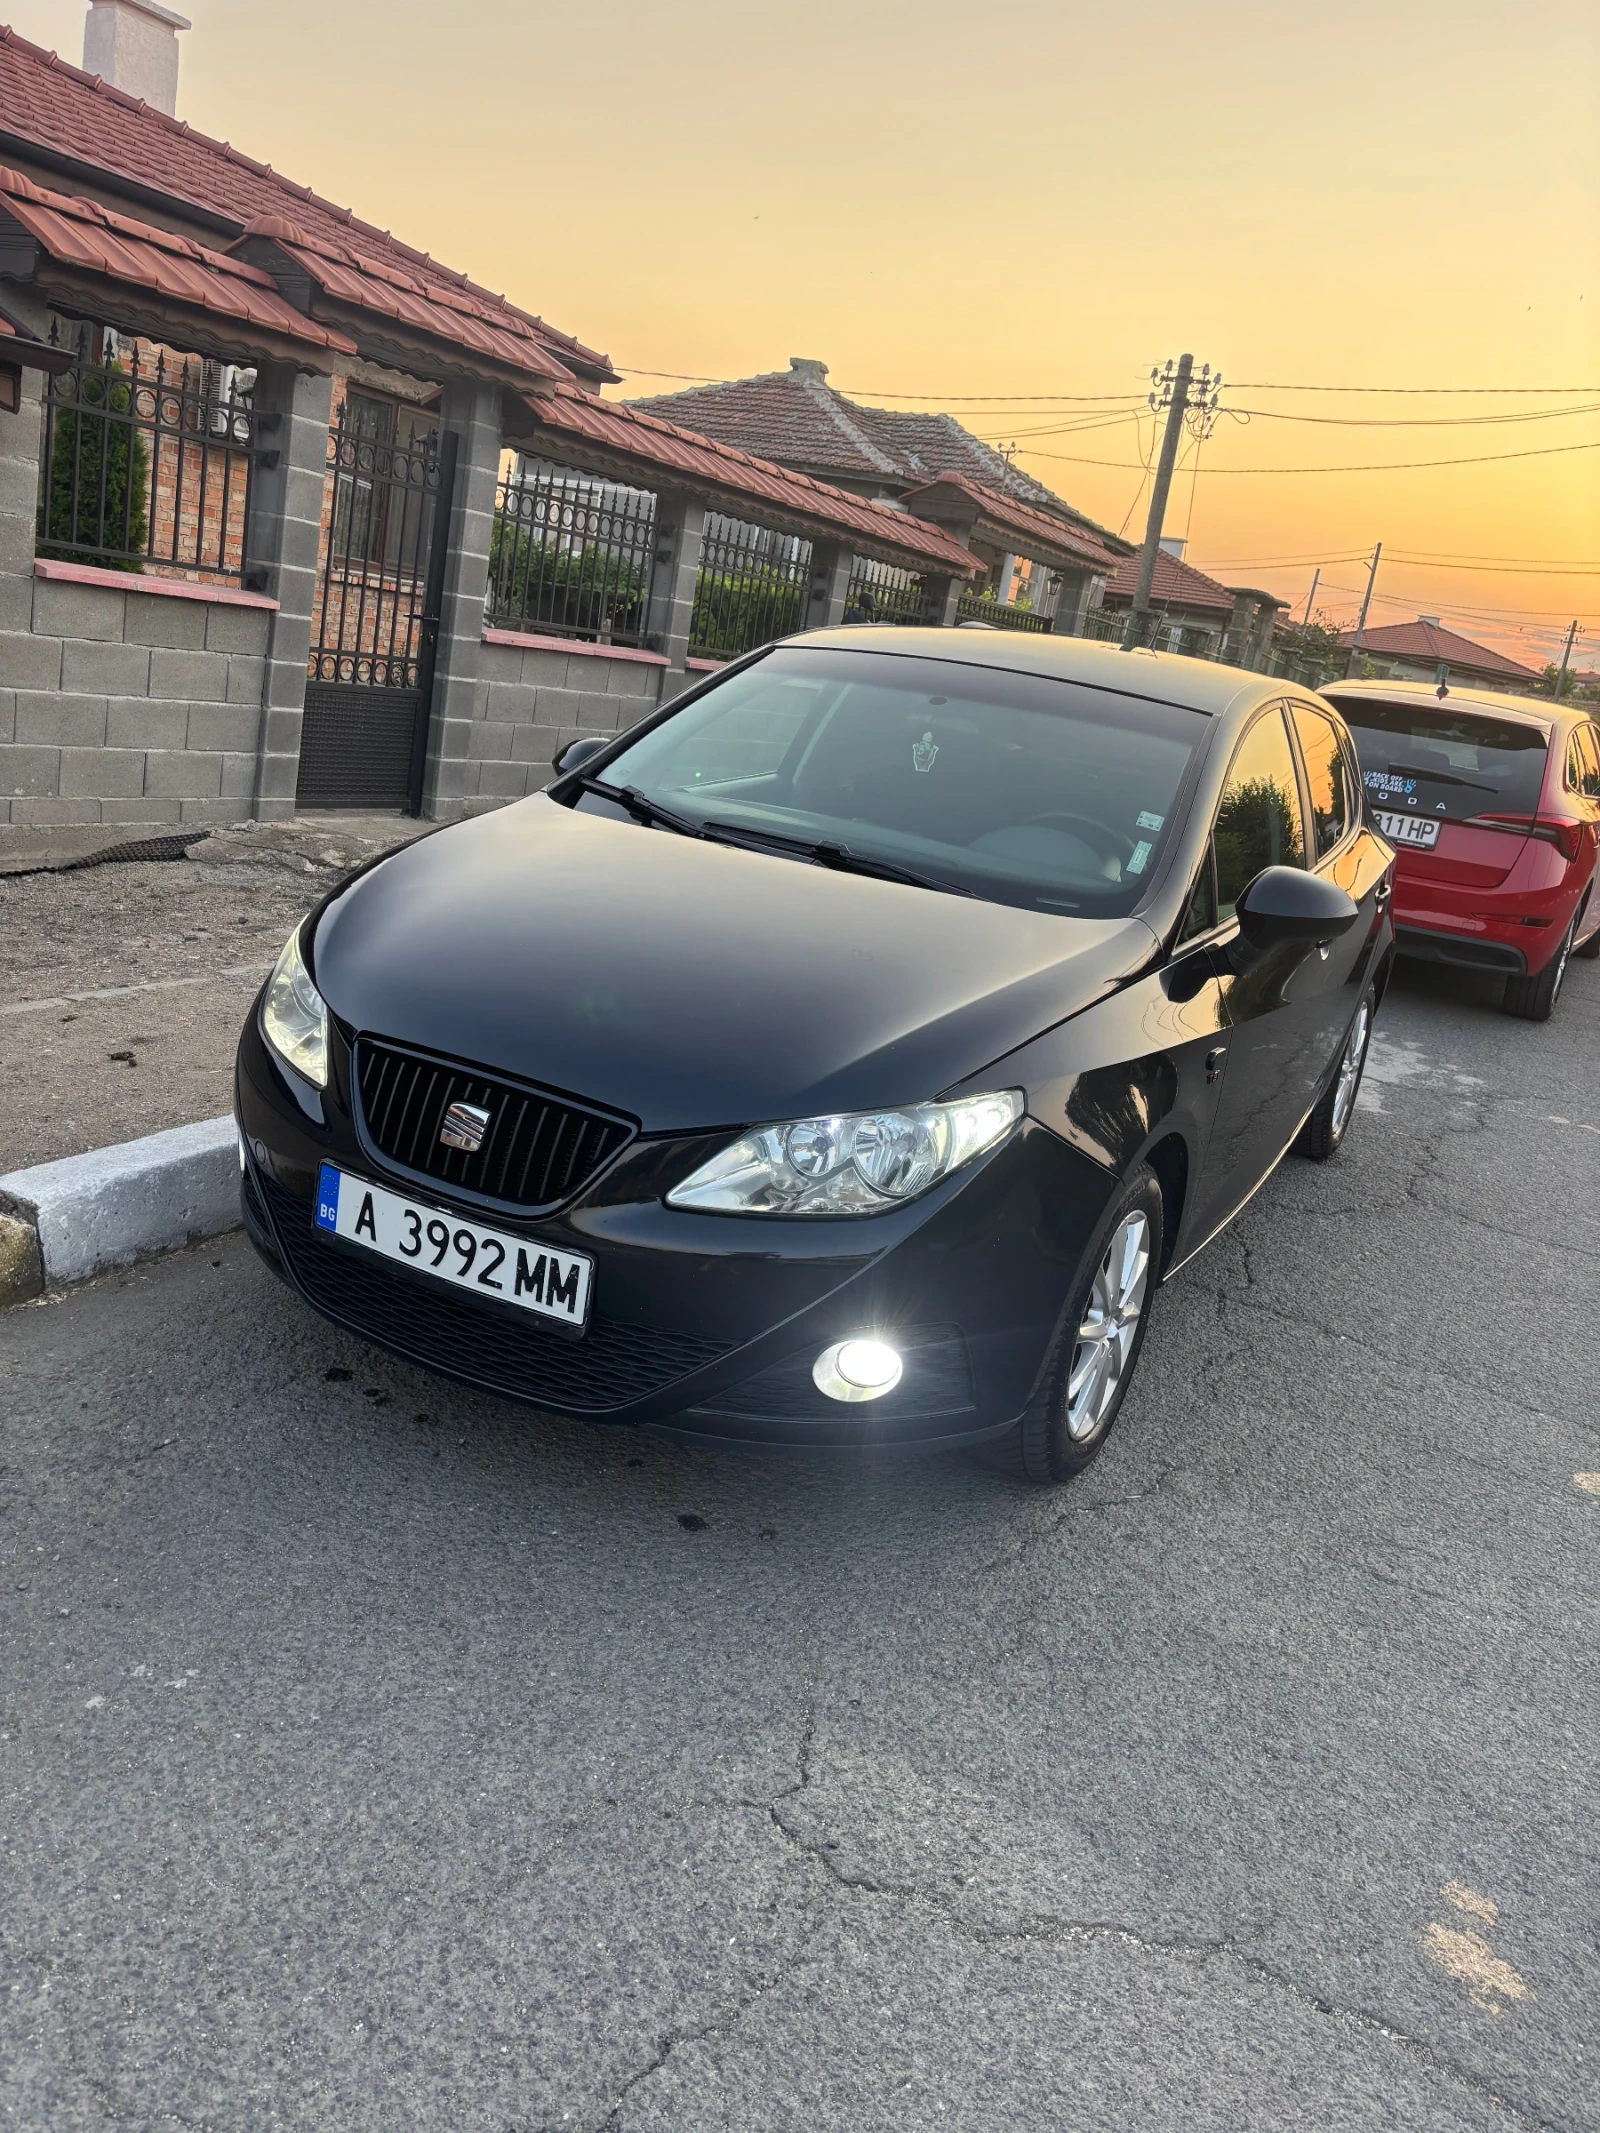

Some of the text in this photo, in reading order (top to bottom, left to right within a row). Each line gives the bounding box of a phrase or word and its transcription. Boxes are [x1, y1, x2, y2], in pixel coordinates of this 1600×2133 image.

[1380, 784, 1403, 793] BOARD
[320, 1203, 336, 1221] BG
[355, 1190, 580, 1314] A 3992 MM
